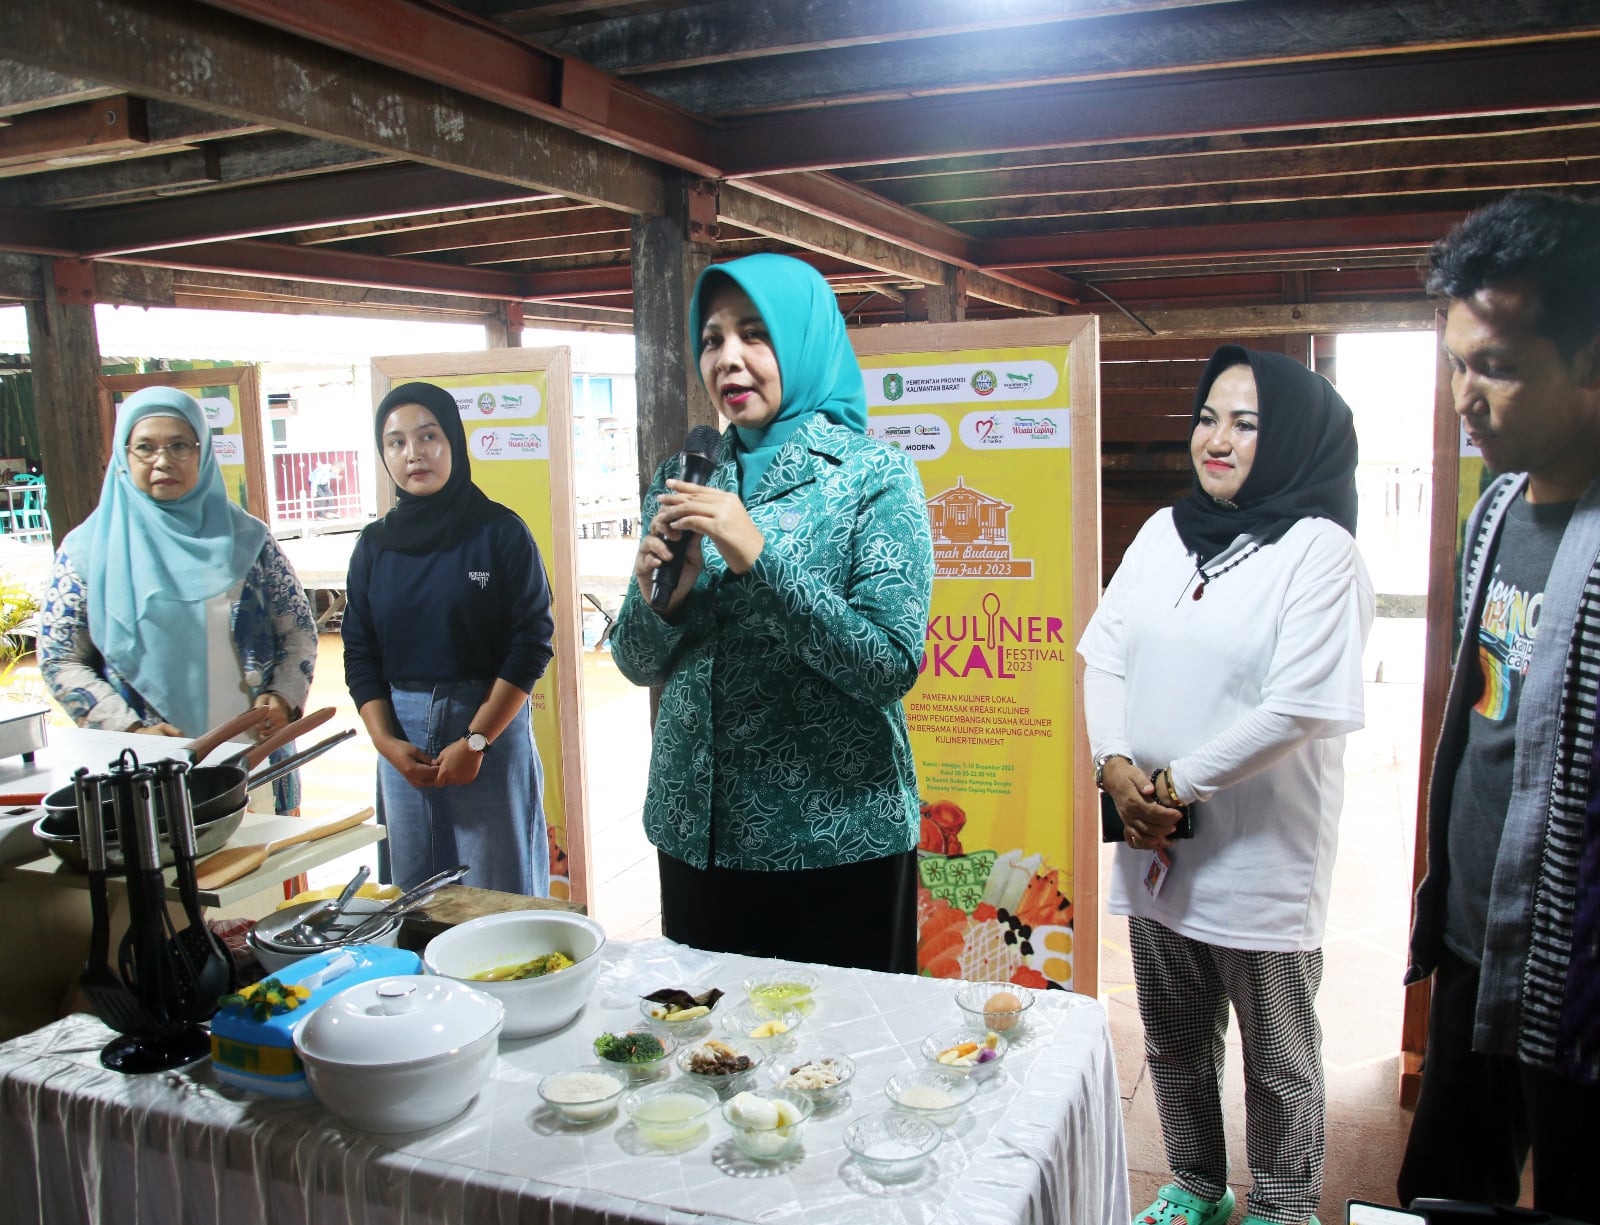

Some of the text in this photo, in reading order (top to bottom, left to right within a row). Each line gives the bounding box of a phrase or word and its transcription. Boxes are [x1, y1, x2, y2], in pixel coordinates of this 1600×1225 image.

[906, 385, 941, 393] KALIMANTAN
[933, 545, 1008, 561] mah Budaya
[984, 563, 1012, 575] 2023
[925, 600, 1065, 649] KULINER
[1006, 648, 1065, 662] FESTIVAL
[1006, 661, 1033, 672] 2023
[922, 693, 1017, 704] PAMERAN KULINER LOKAL
[910, 703, 1030, 715] DEMO MEMASAK KREASI KULINER
[906, 713, 1052, 727] SHOW PENGEMBANGAN USAHA KULINER
[916, 724, 951, 733] BERSAMA
[952, 725, 984, 735] KULINER
[985, 727, 1023, 736] KAMPUNG
[1023, 728, 1053, 738] CAPING
[935, 735, 1005, 746] KULINER-TEINMENT
